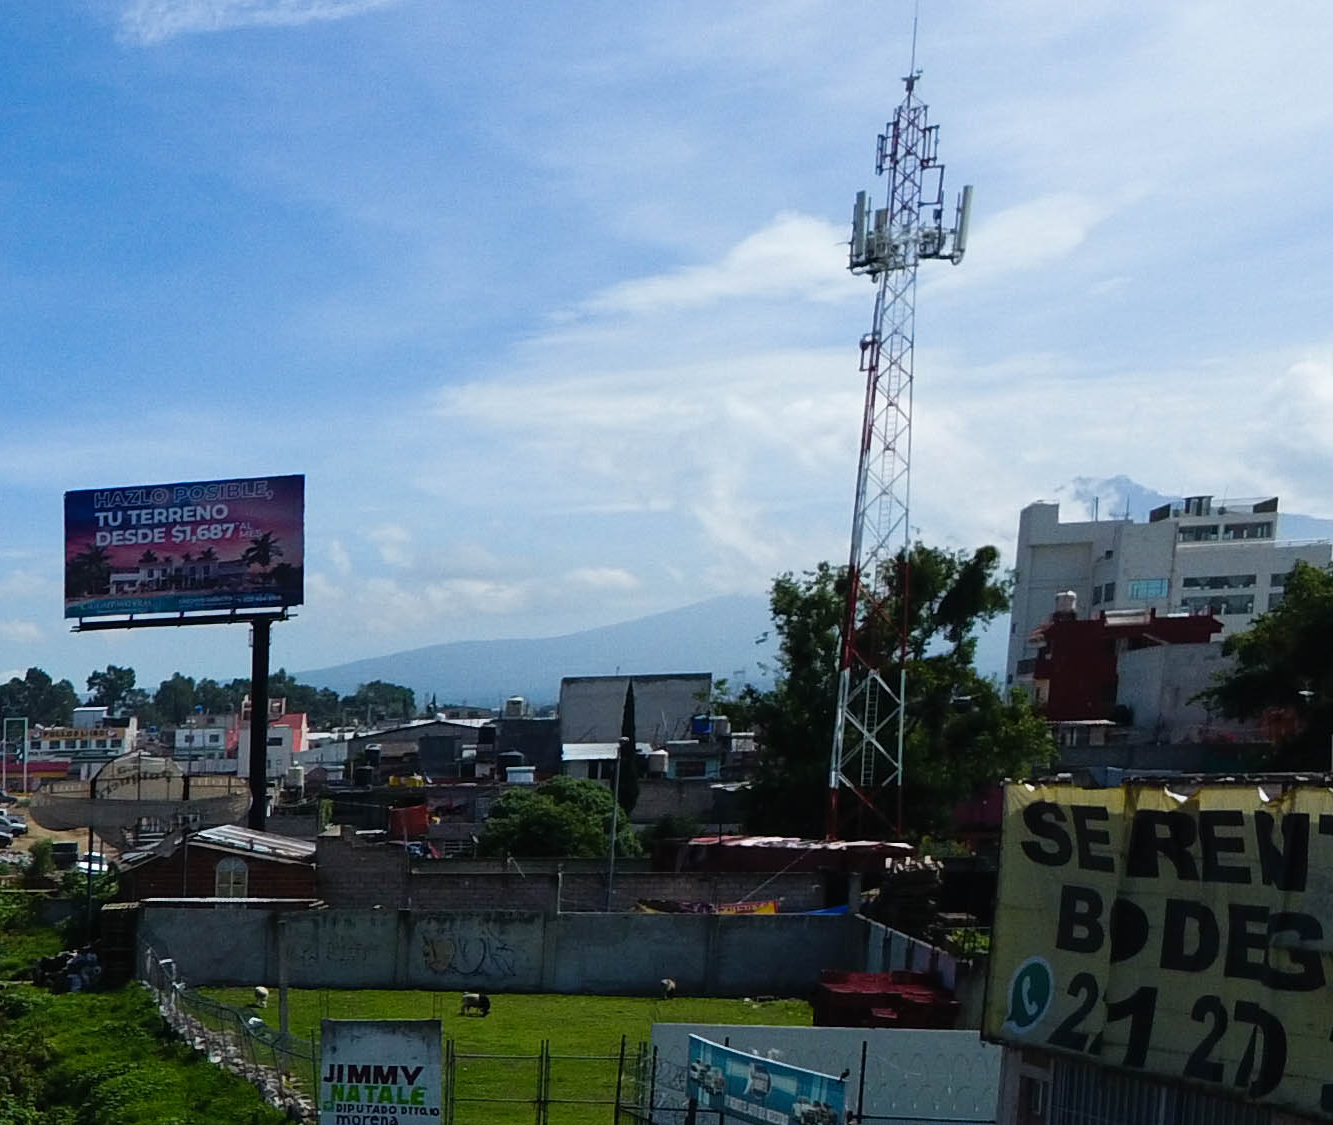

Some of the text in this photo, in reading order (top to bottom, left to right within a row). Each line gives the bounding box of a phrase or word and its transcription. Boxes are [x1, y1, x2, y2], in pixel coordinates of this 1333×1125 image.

[94, 480, 274, 509] HAZLO POSIBLE,
[94, 504, 229, 527] TU TERRENO
[95, 528, 166, 547] DESDE
[1020, 800, 1115, 873] SE
[323, 1063, 425, 1085] JIMMY
[331, 1084, 428, 1106] NATALE
[335, 1103, 397, 1115] DIPUTADO
[335, 1114, 398, 1125] morena
